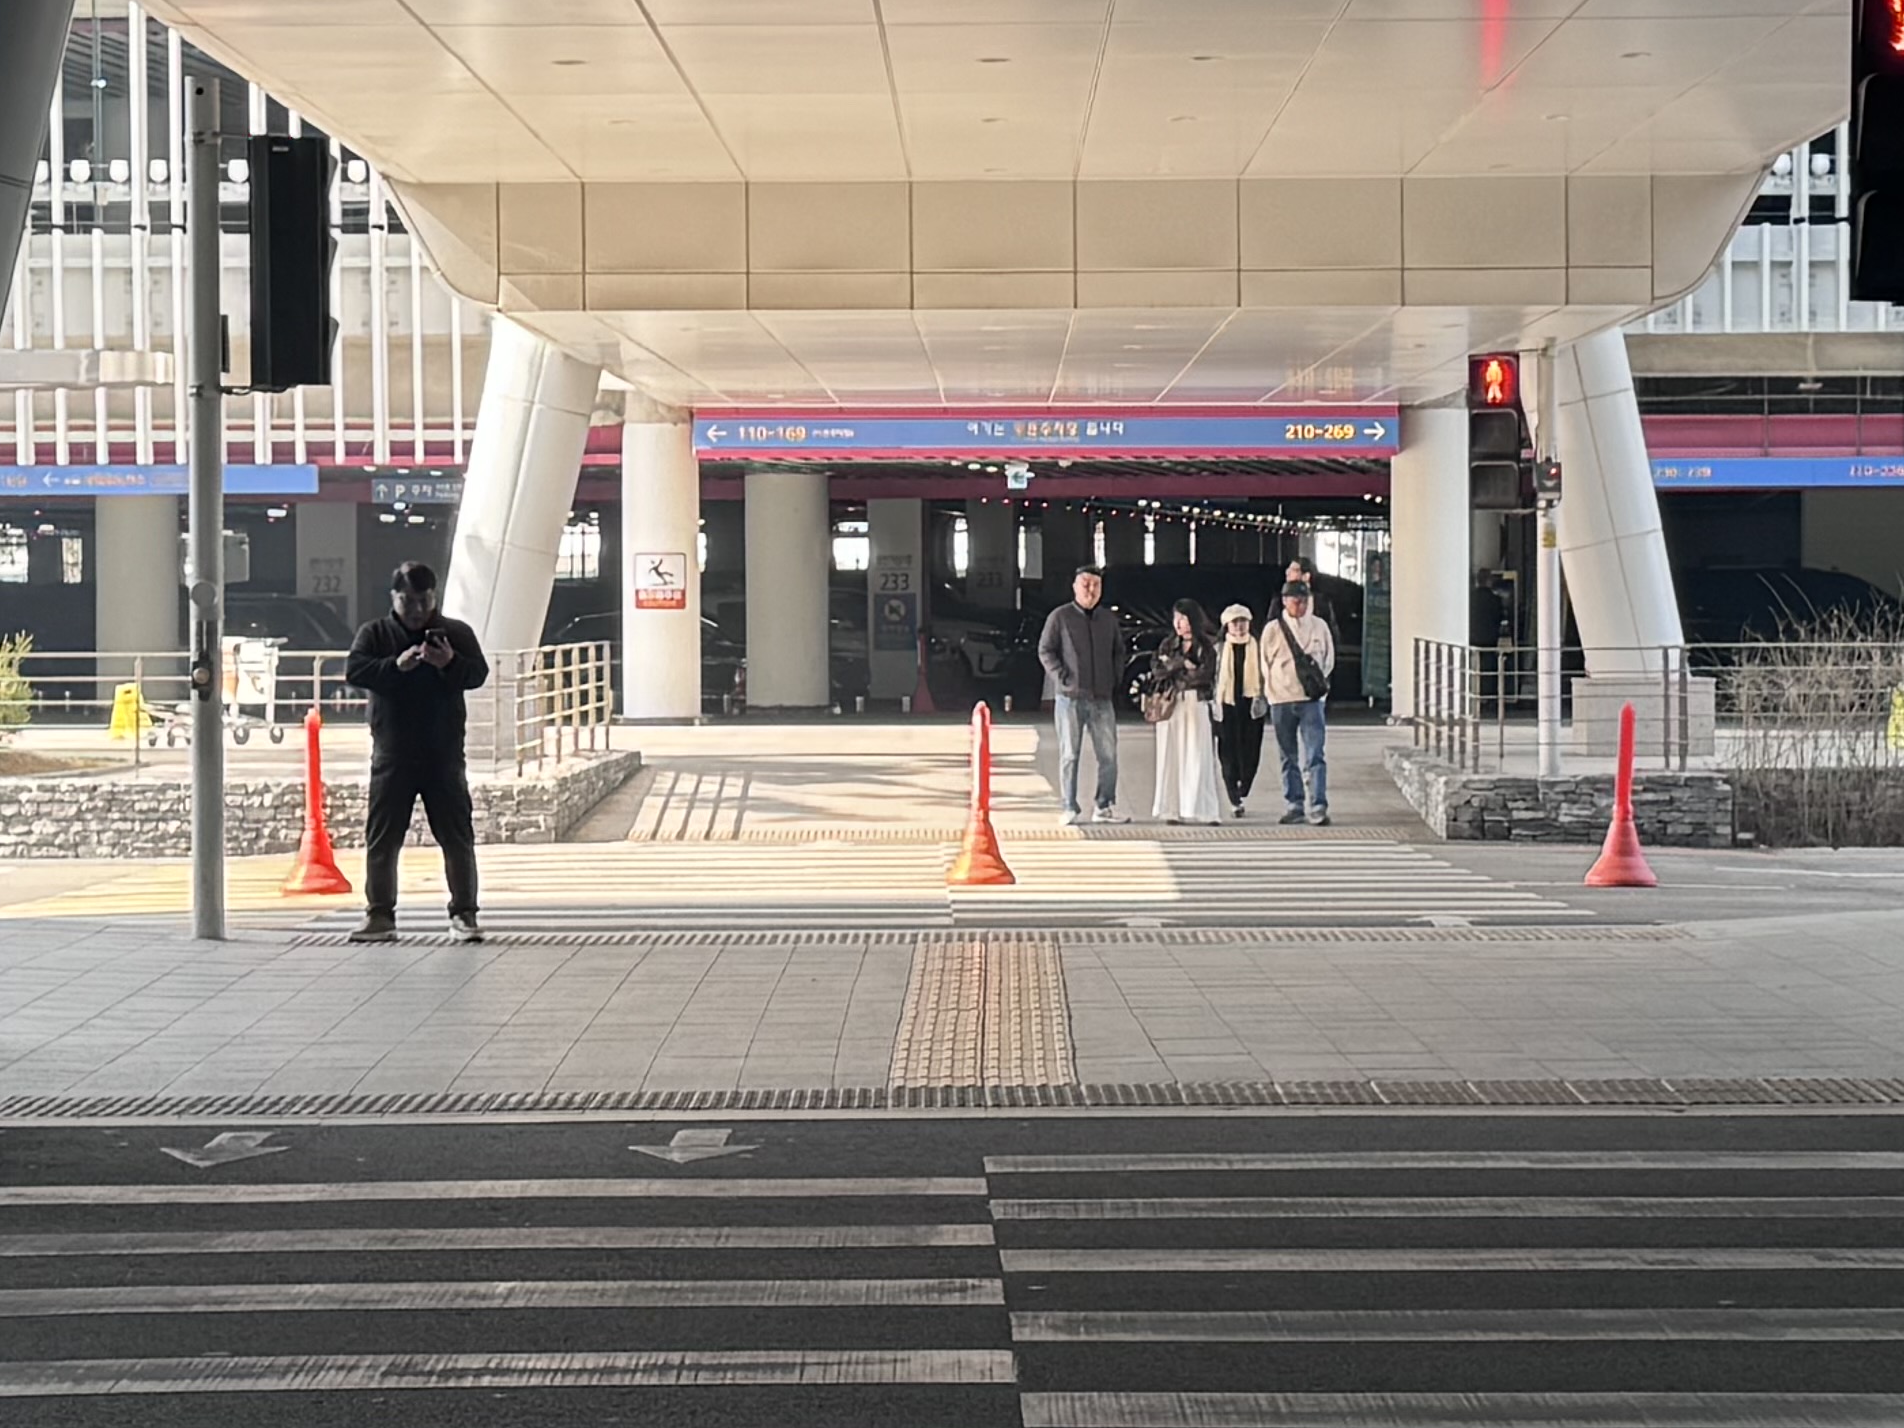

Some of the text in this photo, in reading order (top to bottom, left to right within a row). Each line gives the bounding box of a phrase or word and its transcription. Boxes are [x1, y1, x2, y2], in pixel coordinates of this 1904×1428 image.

[738, 425, 807, 441] 110-169
[1285, 423, 1355, 440] 210-269
[880, 574, 909, 591] 233
